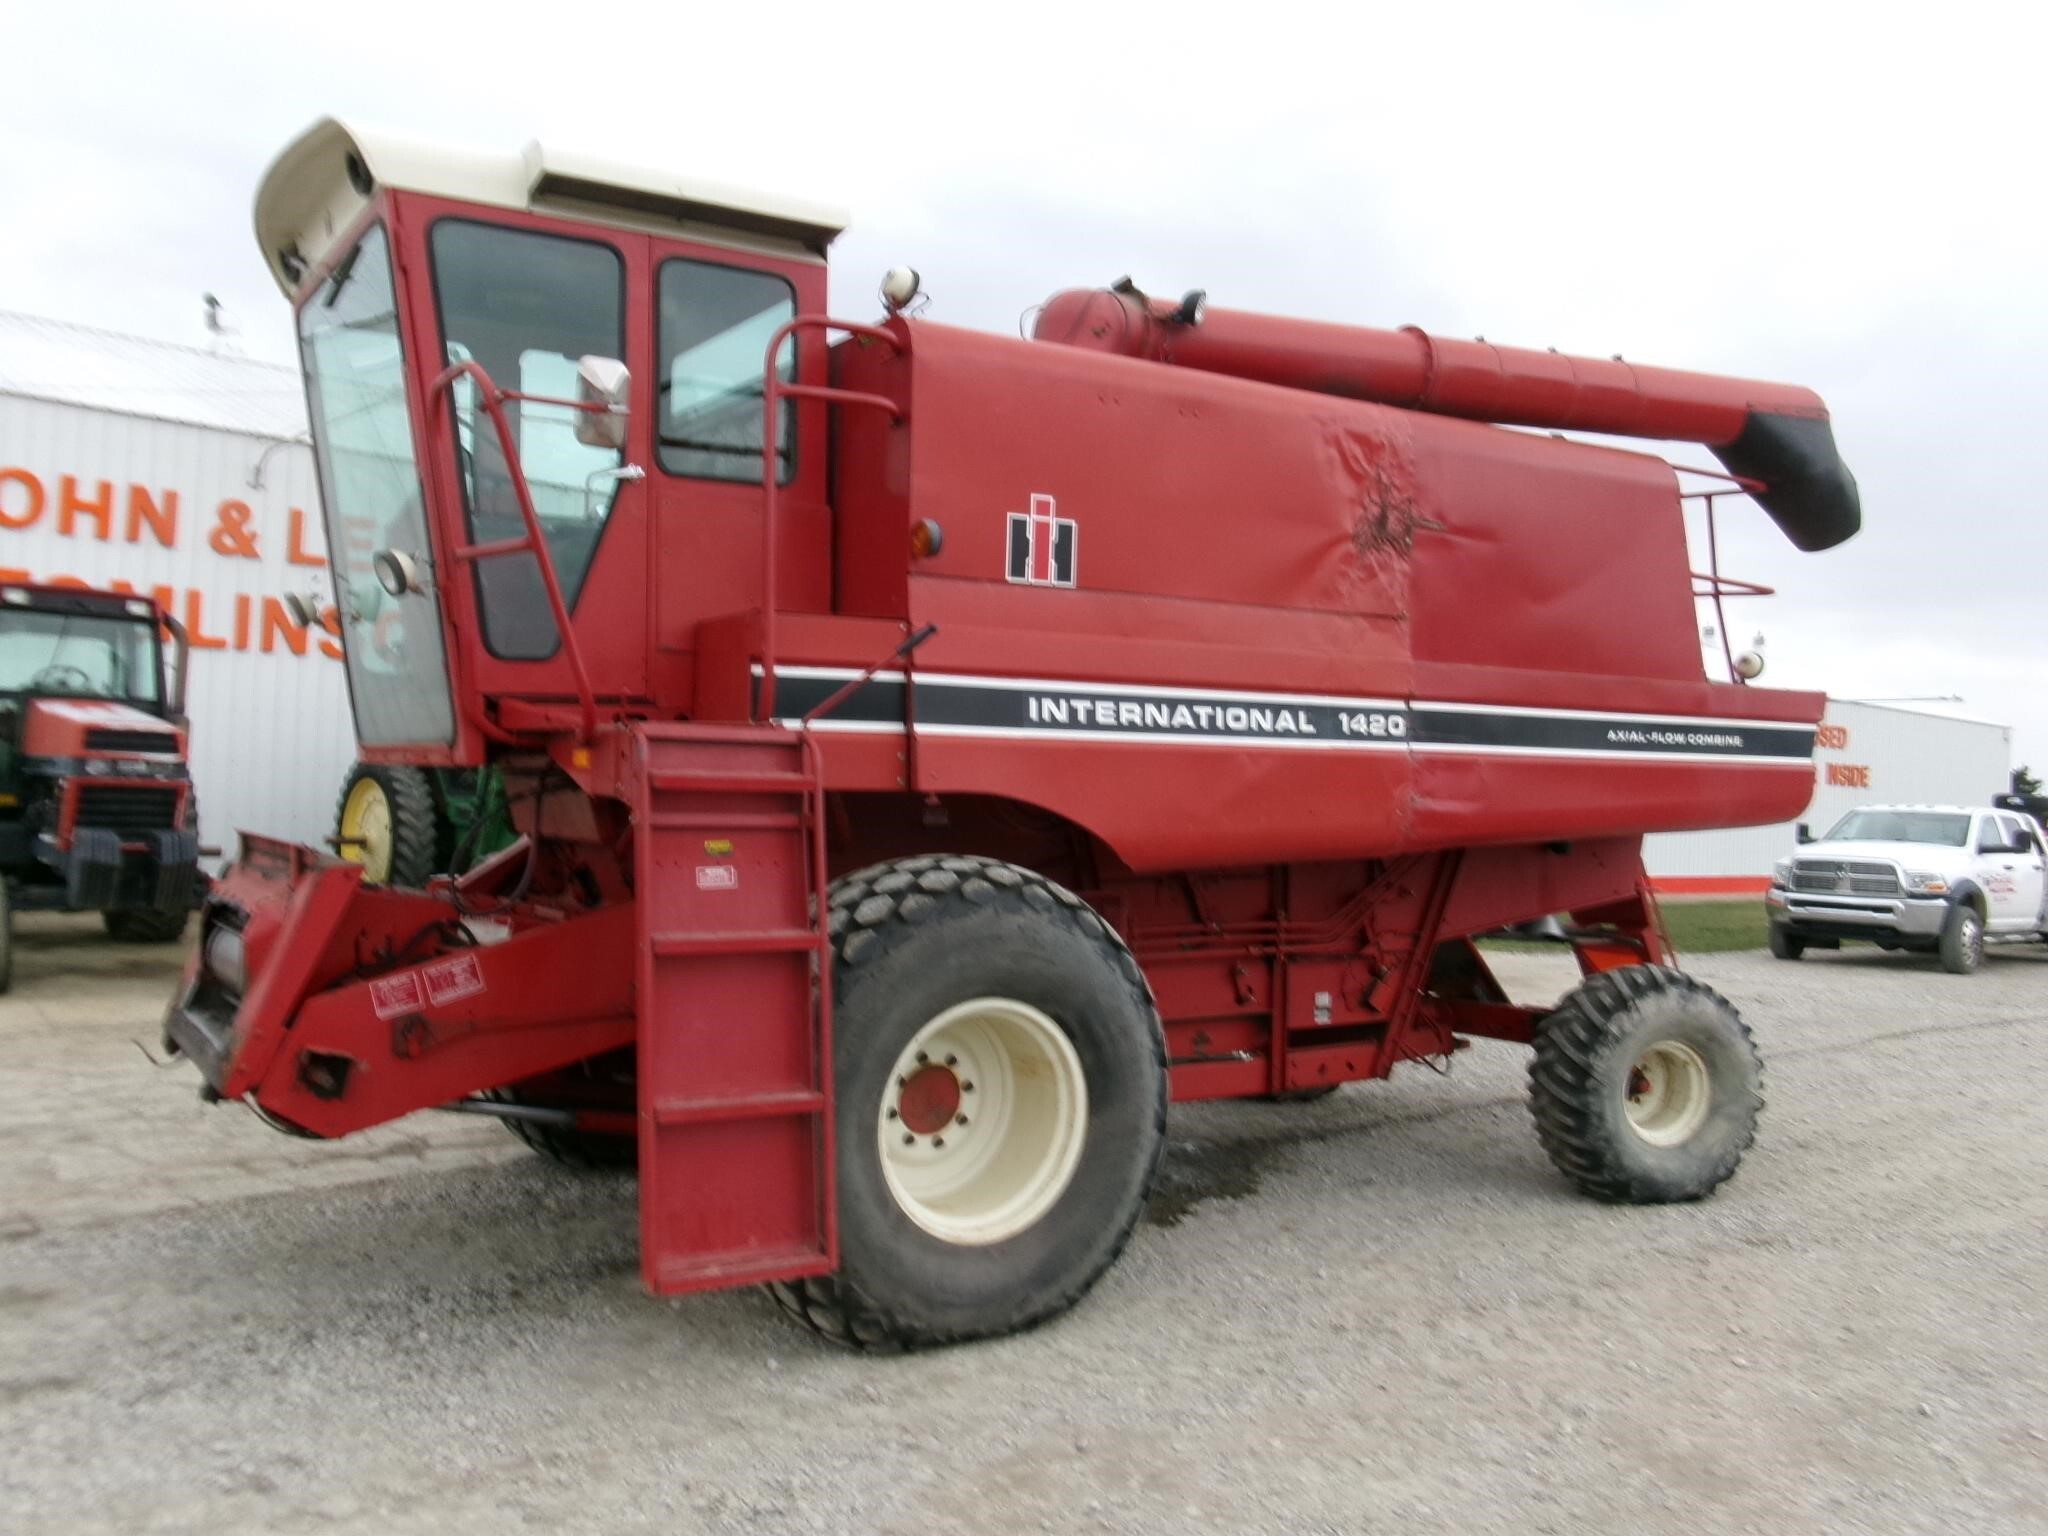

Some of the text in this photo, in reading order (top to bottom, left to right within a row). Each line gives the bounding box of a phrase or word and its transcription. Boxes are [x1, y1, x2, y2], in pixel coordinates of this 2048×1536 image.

[207, 496, 263, 562] &
[1028, 695, 1407, 737] INTERNATIONAL 1420
[1687, 733, 1744, 748] COMBINE
[1816, 726, 1847, 750] SED
